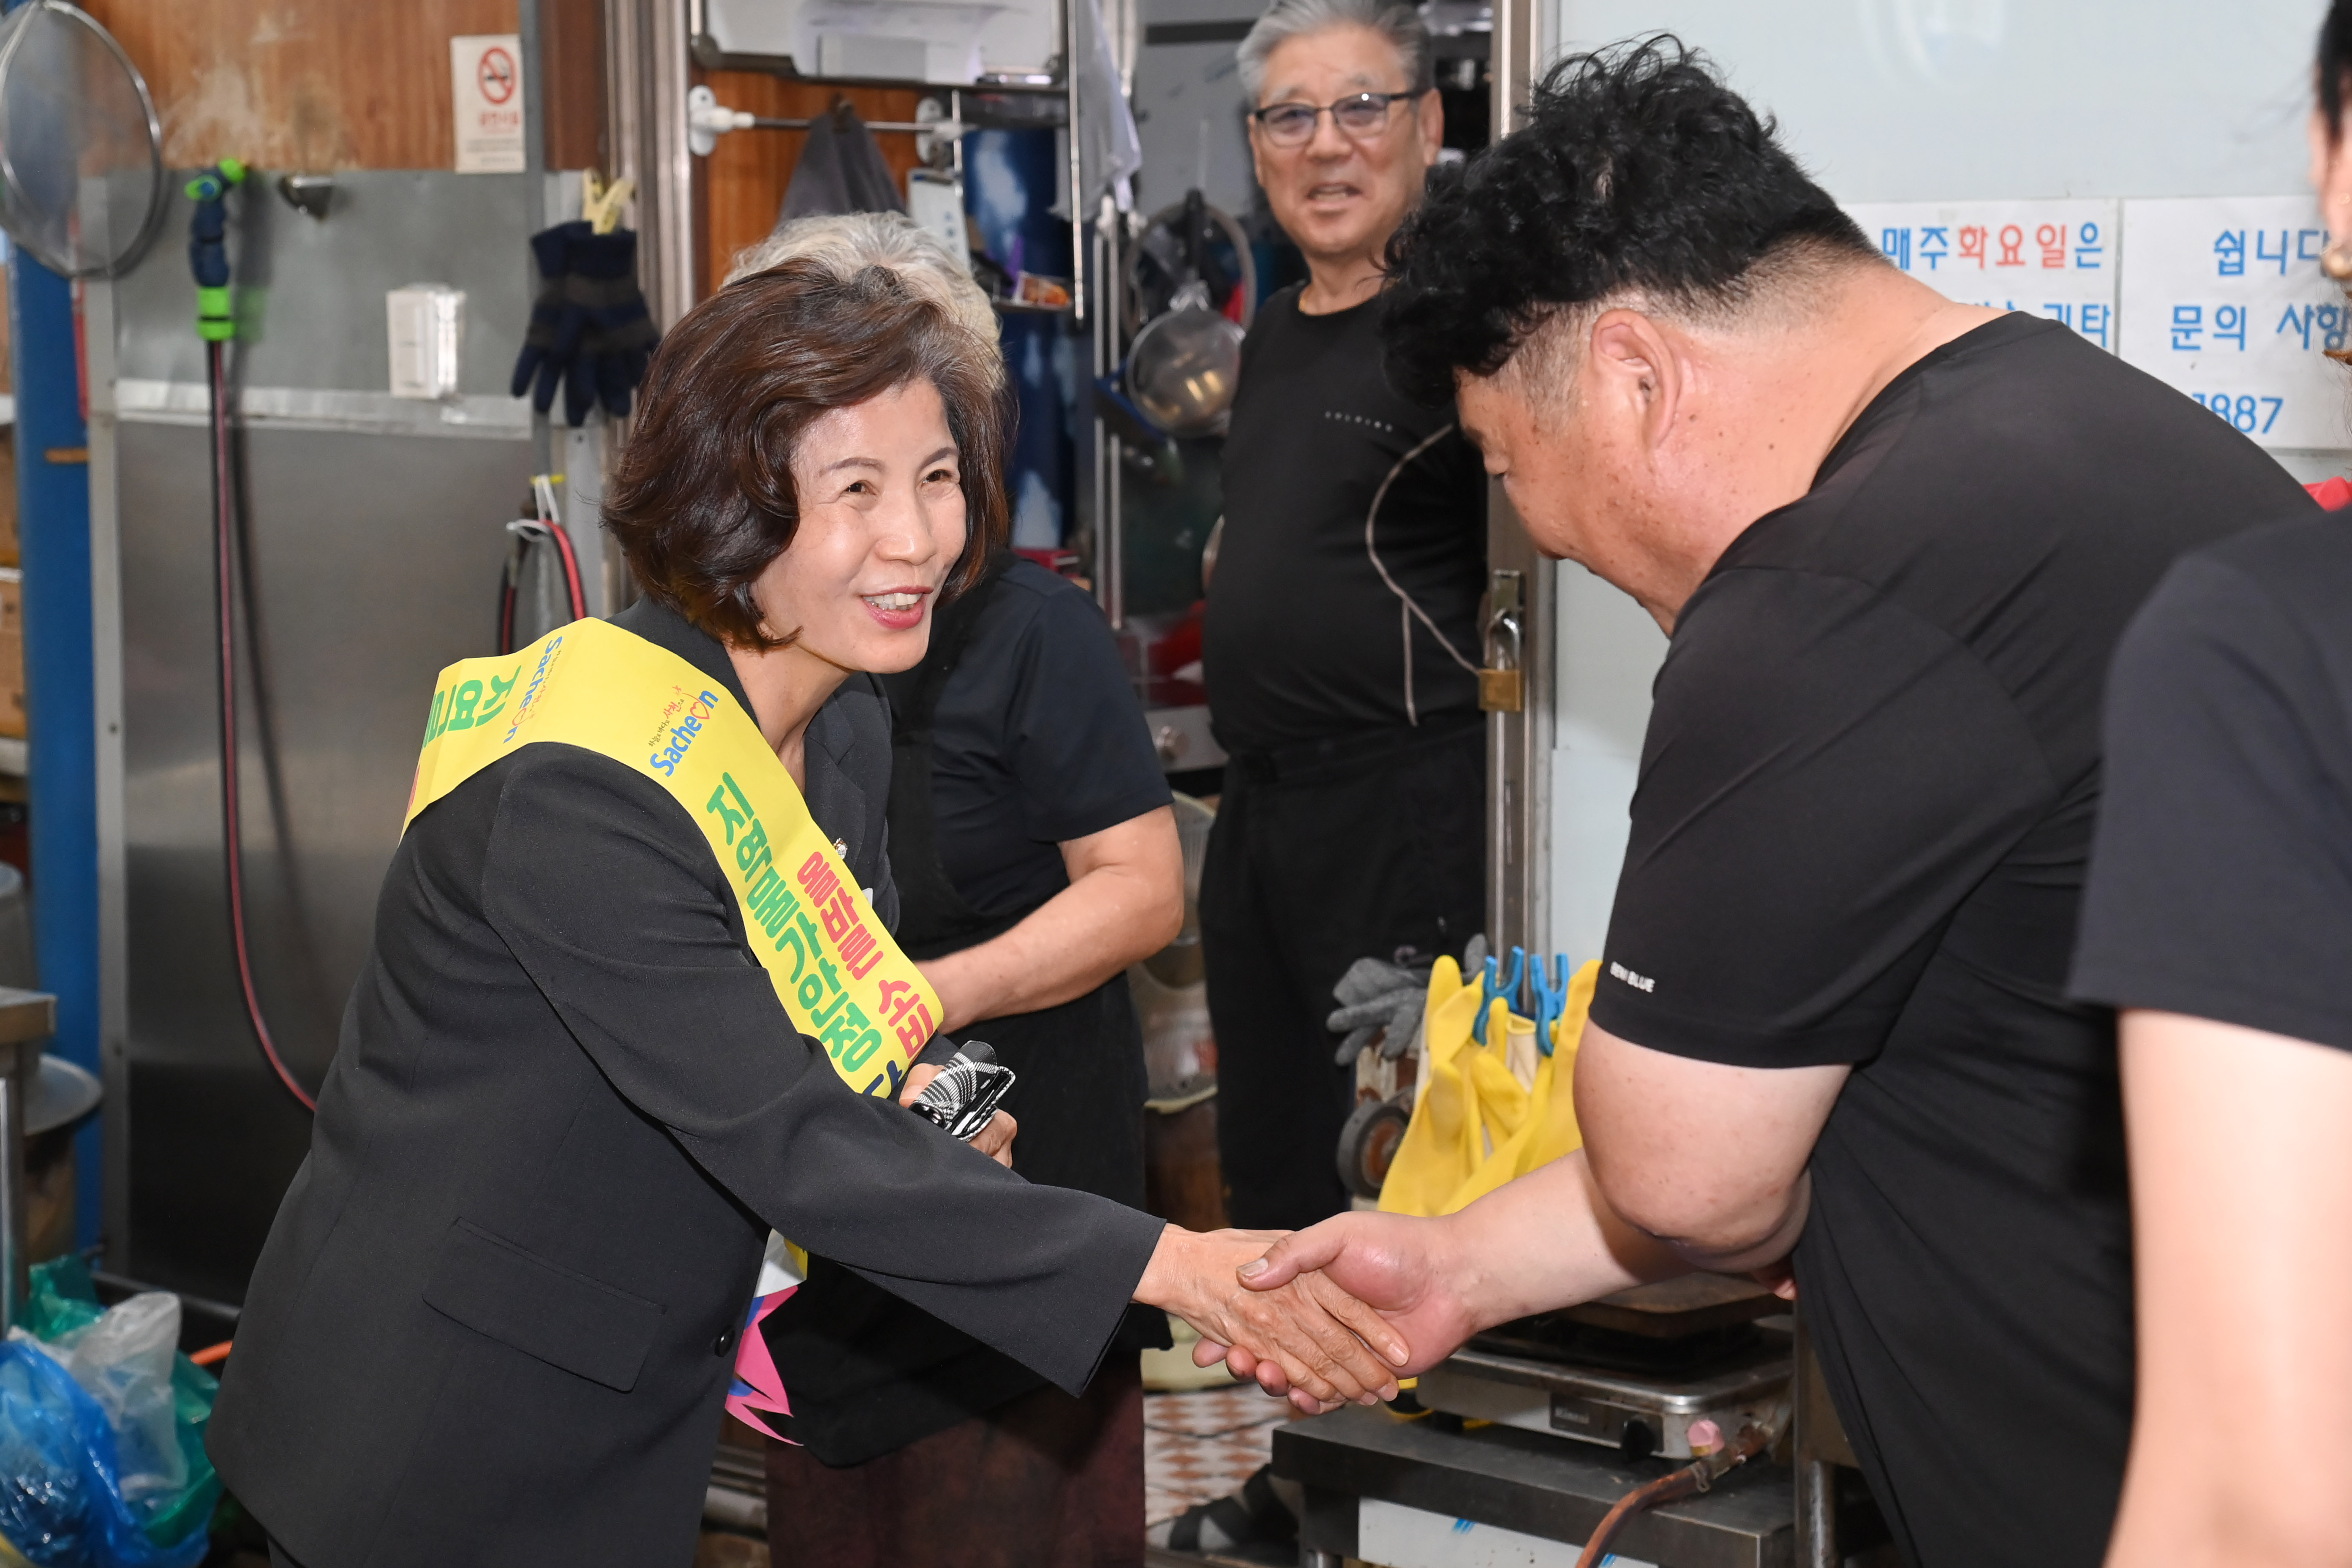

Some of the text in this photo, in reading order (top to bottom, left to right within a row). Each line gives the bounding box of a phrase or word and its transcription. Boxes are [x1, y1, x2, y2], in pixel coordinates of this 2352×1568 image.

[2214, 228, 2331, 277] 쉽니다
[2171, 302, 2349, 351] 문의 사항
[797, 851, 884, 980] 올바른
